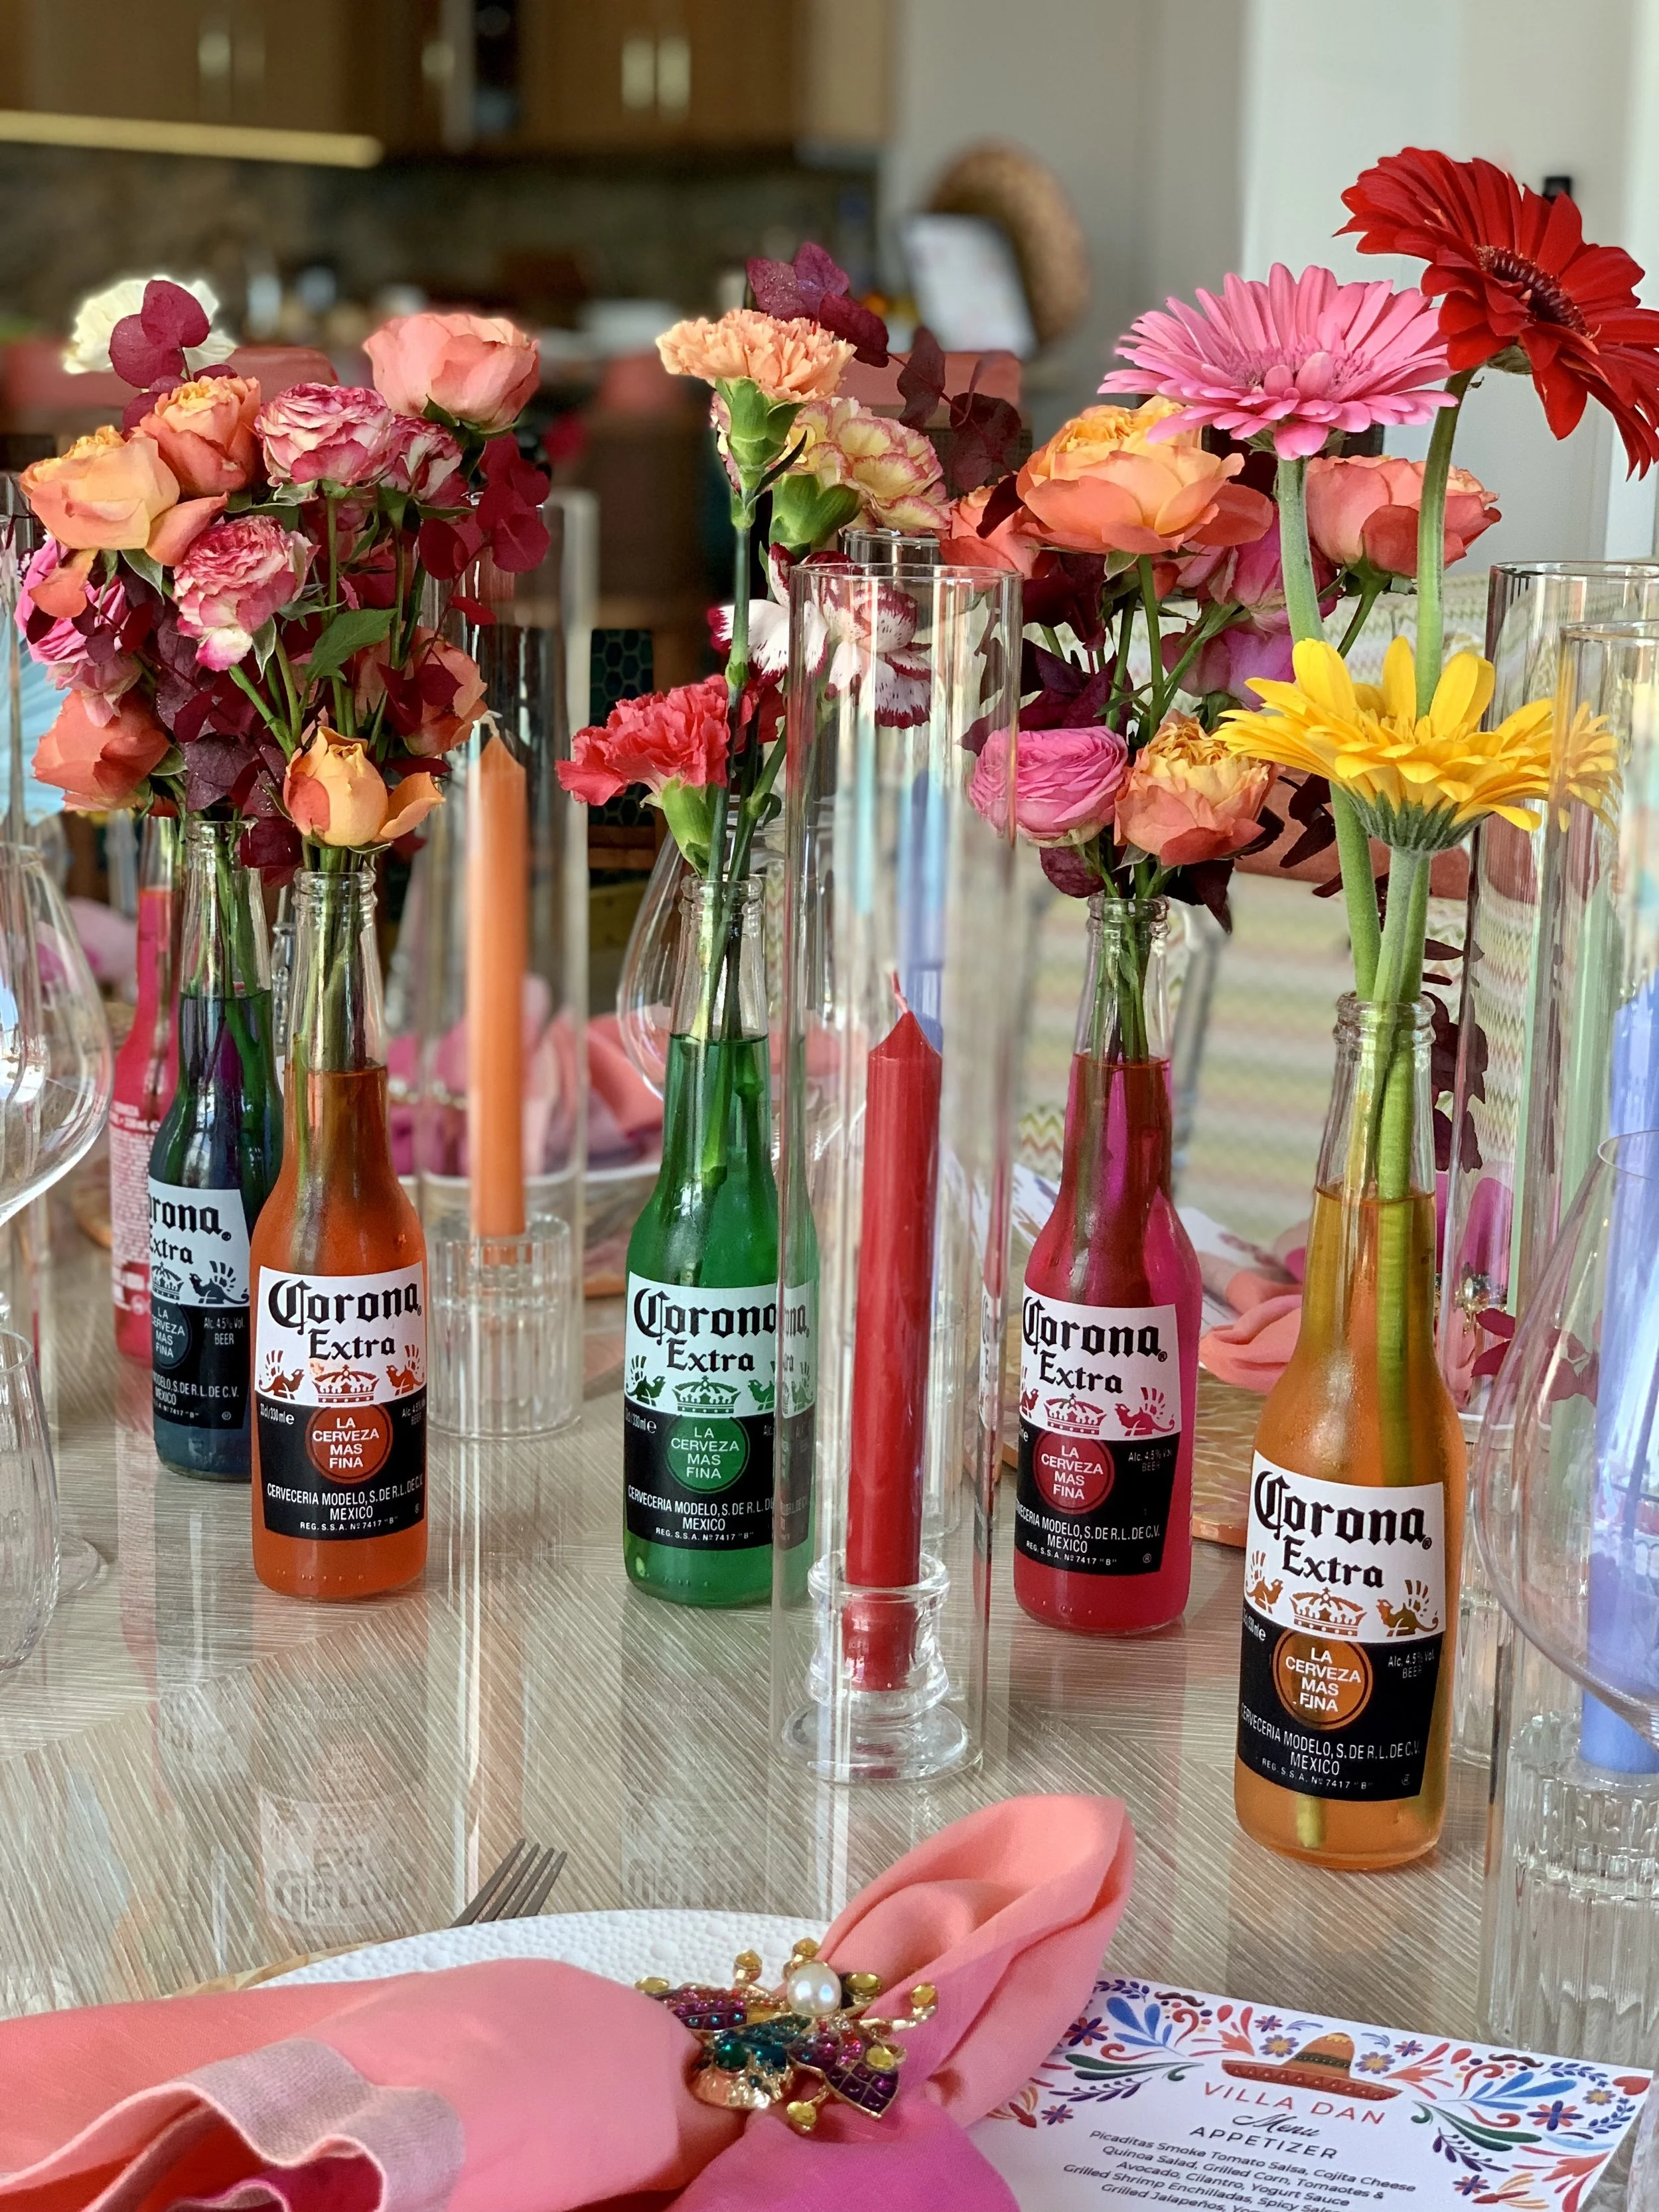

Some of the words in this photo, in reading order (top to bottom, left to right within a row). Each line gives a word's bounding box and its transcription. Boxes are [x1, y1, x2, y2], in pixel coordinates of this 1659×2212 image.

[147, 1193, 223, 1235] orona
[158, 1306, 169, 1320] LA
[269, 1280, 419, 1335] Corona
[1023, 1295, 1161, 1358] Corona
[156, 1330, 173, 1346] MAS
[214, 1333, 234, 1345] BEER
[309, 1328, 396, 1360] Extra
[156, 1342, 174, 1359] FINA
[666, 1338, 755, 1372] Extra
[1039, 1349, 1123, 1394] Extra
[155, 1386, 177, 1406] MEXICO
[180, 1382, 190, 1395] DE
[209, 1386, 220, 1398] DE
[336, 1418, 356, 1428] LA
[694, 1427, 714, 1438] LA
[313, 1428, 380, 1442] CERVEZA
[671, 1438, 739, 1451] CERVEZA
[330, 1443, 362, 1455] MAS
[687, 1453, 721, 1465] MAS
[1062, 1445, 1079, 1459] LA
[330, 1457, 364, 1469] FINA
[686, 1467, 721, 1479] FINA
[1041, 1453, 1104, 1475] CERVEZA
[1054, 1470, 1085, 1486] MAS
[267, 1483, 319, 1505] CERVECERIA
[379, 1488, 390, 1501] DE
[628, 1485, 672, 1512] CERVECERIA
[732, 1503, 744, 1515] DE
[1053, 1483, 1085, 1500] FINA
[330, 1505, 373, 1520] MEXICO
[1254, 1471, 1427, 1545] Corona
[300, 1522, 319, 1530] REG.
[363, 1520, 382, 1529] 7417
[656, 1527, 673, 1537] REG.
[683, 1516, 725, 1531] MEXICO
[1095, 1526, 1108, 1540] DE
[1131, 1526, 1144, 1540] DE
[1047, 1533, 1088, 1554] MEXICO
[1076, 1556, 1096, 1564] 7417
[1282, 1534, 1384, 1588] Extra
[1311, 1647, 1333, 1664] LA
[1285, 1656, 1361, 1682] CERVEZA
[1301, 1676, 1338, 1696] MAS
[1299, 1692, 1338, 1712] FINA
[1242, 1702, 1281, 1742] CERVECERIA
[1349, 1744, 1364, 1759] DE
[1390, 1743, 1404, 1759] DE
[1290, 1751, 1340, 1775] MEXICO
[1326, 1778, 1350, 1789] 7417
[1204, 2081, 1293, 2110] VILLA
[1311, 2101, 1386, 2124] DAN
[1232, 2113, 1321, 2137] Menu
[1189, 2126, 1338, 2159] APPETIZER
[1090, 2130, 1155, 2149] Picaditas
[1157, 2142, 1206, 2158] Smoke
[1211, 2151, 1266, 2168] Tomato
[1268, 2161, 1309, 2175] Salsa,
[1313, 2168, 1357, 2183] Cojita
[1360, 2176, 1416, 2192] Cheese
[1102, 2146, 1154, 2162] Quinoa
[1157, 2154, 1198, 2170] Salad,
[1203, 2162, 1251, 2177] Grilled
[1254, 2172, 1291, 2186] Corn,
[1296, 2178, 1370, 2198] Tomaotes
[1373, 2190, 1384, 2200] &
[1063, 2164, 1112, 2179] Grilled
[1112, 2172, 1165, 2189] Shrimp
[1168, 2181, 1253, 2204] Enchilladas,
[1258, 2197, 1300, 2211] Spicy
[1116, 2161, 1181, 2179] Avocado,
[1186, 2173, 1245, 2190] Cilantro,
[1252, 2182, 1302, 2198] Yogurt
[1303, 2192, 1350, 2207] Sauce
[1102, 2183, 1149, 2198] Grilled
[1151, 2191, 1226, 2212] Jalapeños,
